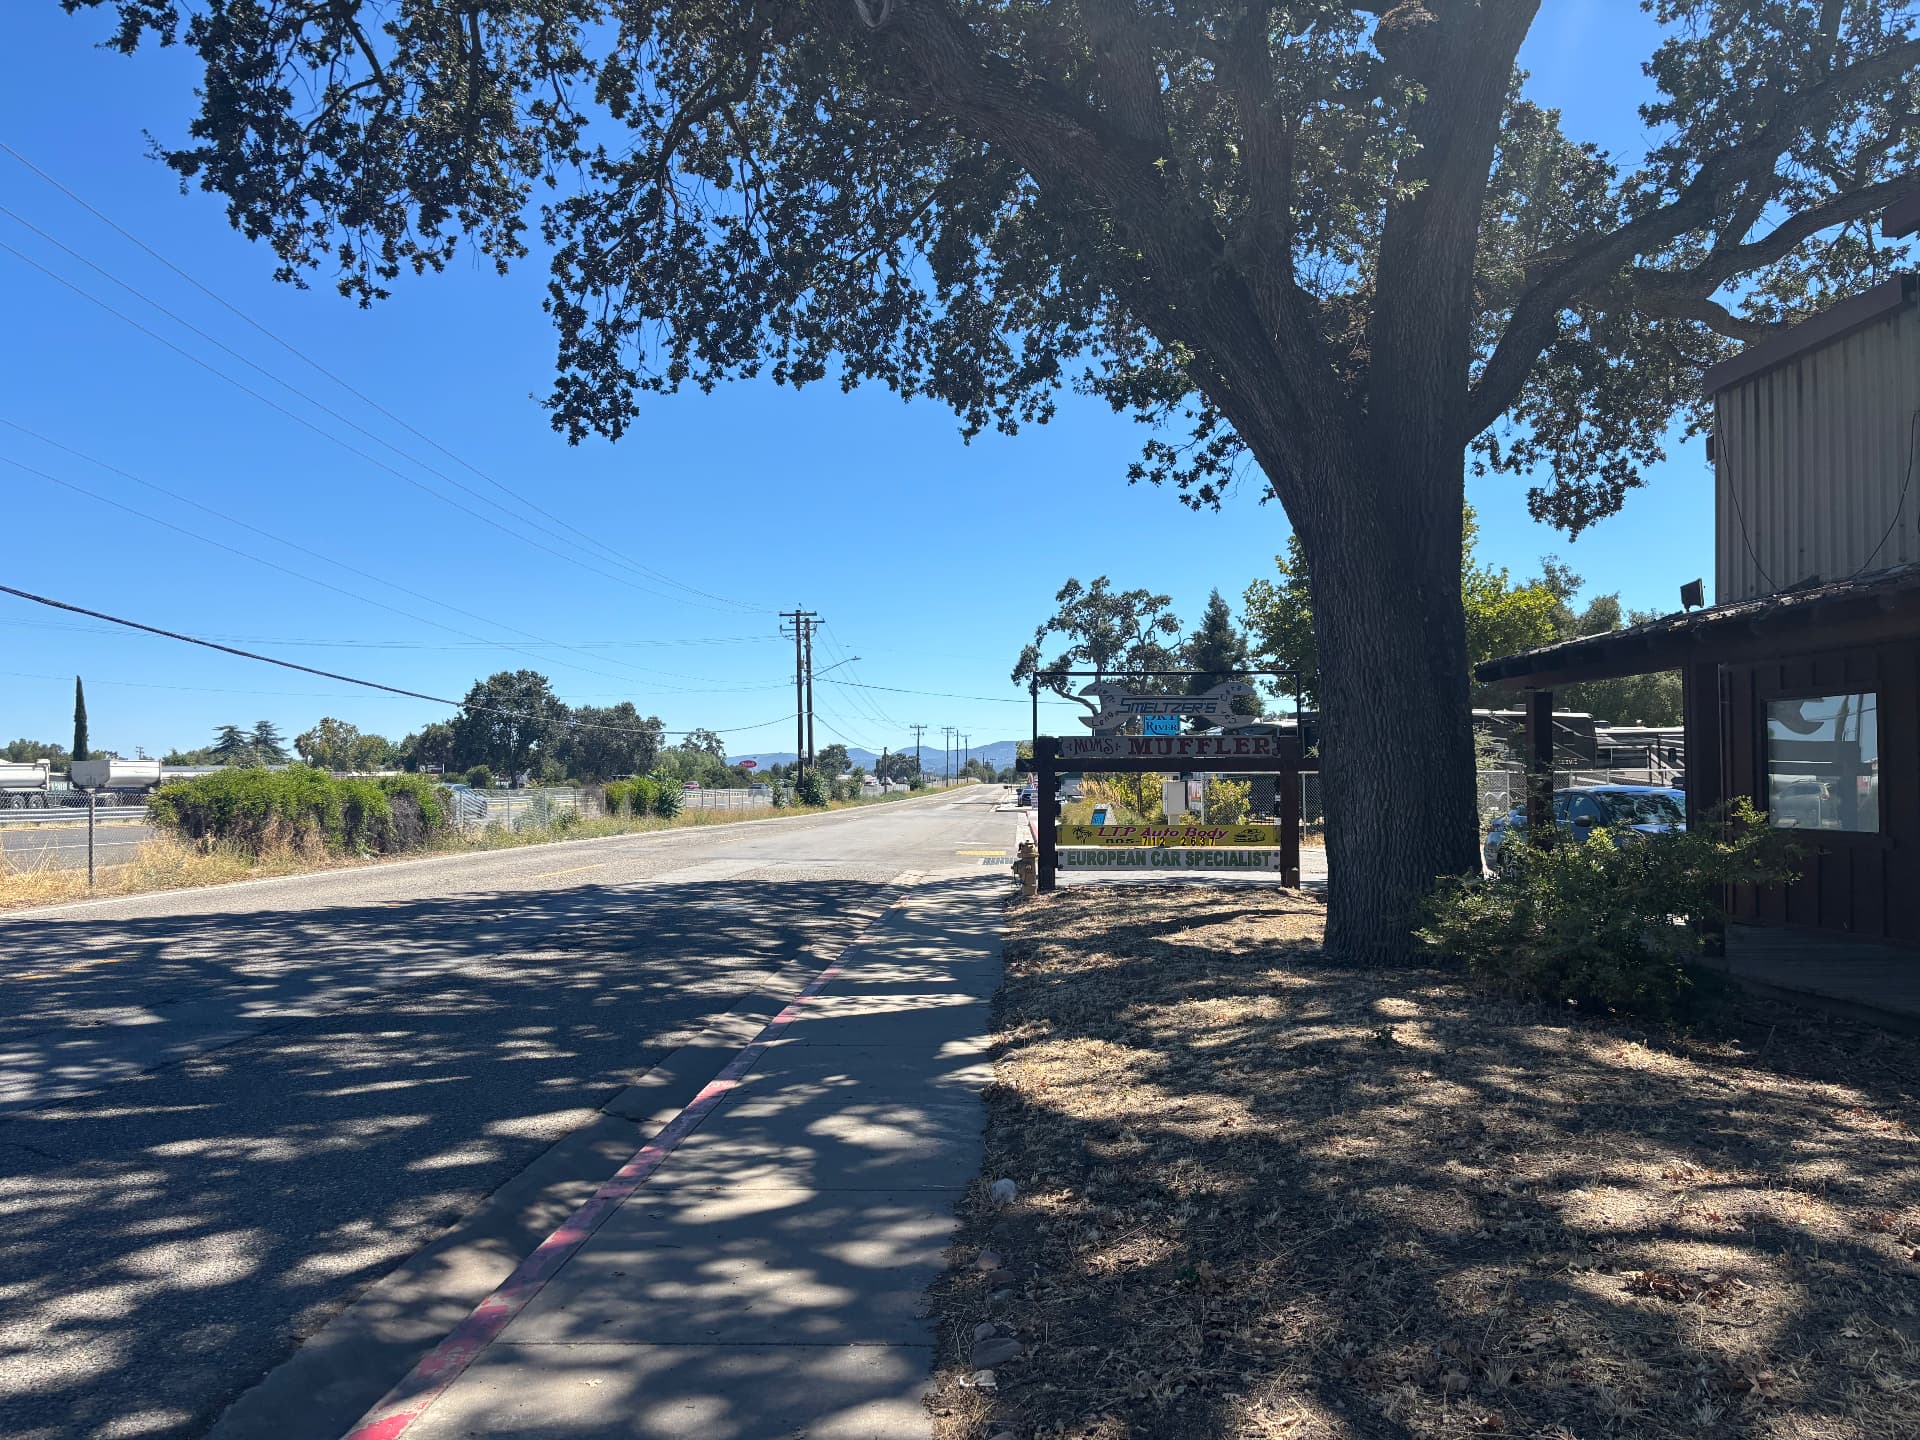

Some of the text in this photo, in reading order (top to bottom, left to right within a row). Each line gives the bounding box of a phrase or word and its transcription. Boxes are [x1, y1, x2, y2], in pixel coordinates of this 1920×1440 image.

[1128, 738, 1270, 756] MUFFLER
[1140, 826, 1180, 837] Auto
[1184, 826, 1230, 839] Body
[1067, 851, 1272, 867] EUROPEAN CAR SPECIALIST
